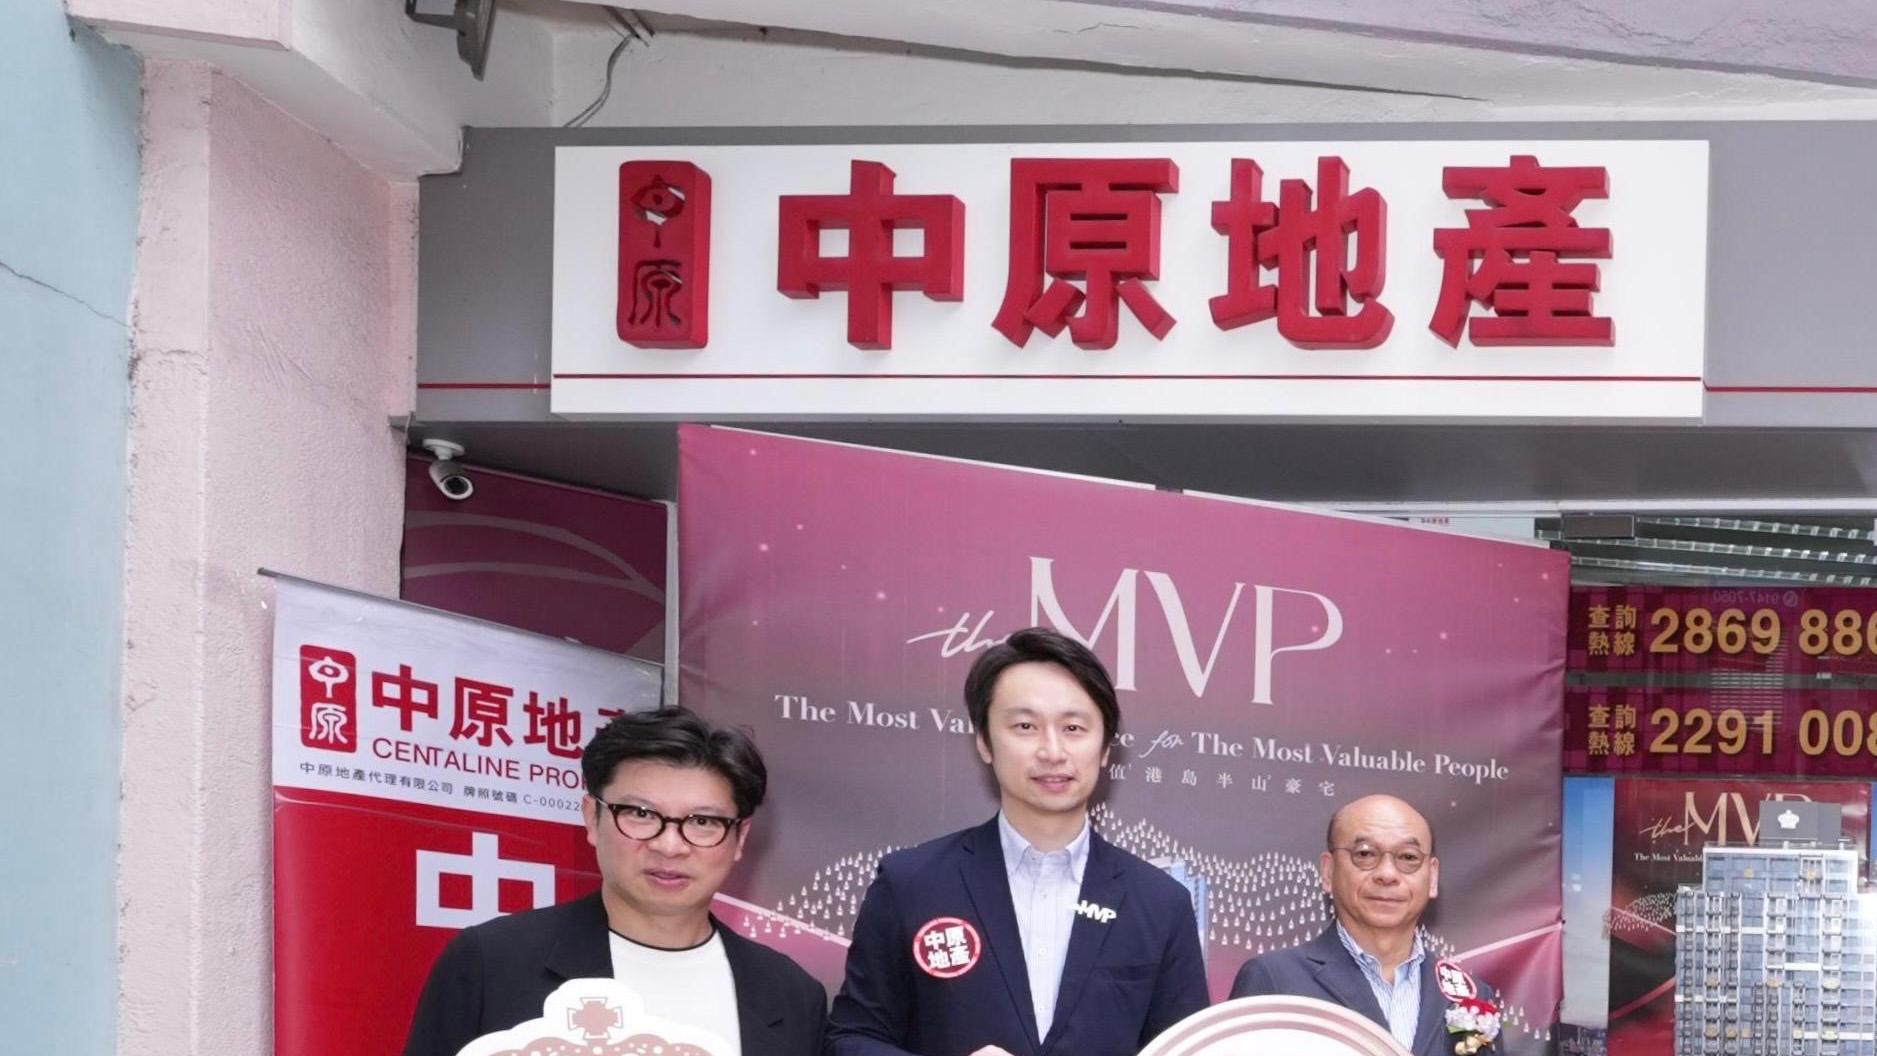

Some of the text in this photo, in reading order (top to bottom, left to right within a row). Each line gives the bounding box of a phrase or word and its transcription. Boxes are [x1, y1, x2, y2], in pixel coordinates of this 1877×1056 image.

[777, 154, 1616, 350] 中原地產
[1028, 555, 1344, 705] MVP
[1587, 604, 1637, 629] 查詢
[1649, 607, 1782, 655] 2869
[1587, 631, 1637, 657] 熱線
[371, 663, 625, 761] 中原地
[1587, 704, 1637, 729] 查詢
[1649, 707, 1774, 755] 2291
[372, 737, 520, 780] CENTALINE
[774, 693, 837, 723] The
[846, 700, 920, 731] Most
[1138, 730, 1185, 758] for
[1191, 730, 1243, 759] The
[1252, 735, 1312, 765] Most
[1318, 743, 1426, 774] Valuable
[1431, 752, 1510, 786] People
[1587, 730, 1637, 757] 熱線
[299, 760, 454, 796] 中原地產代理有限公司
[523, 793, 580, 812] C-00022
